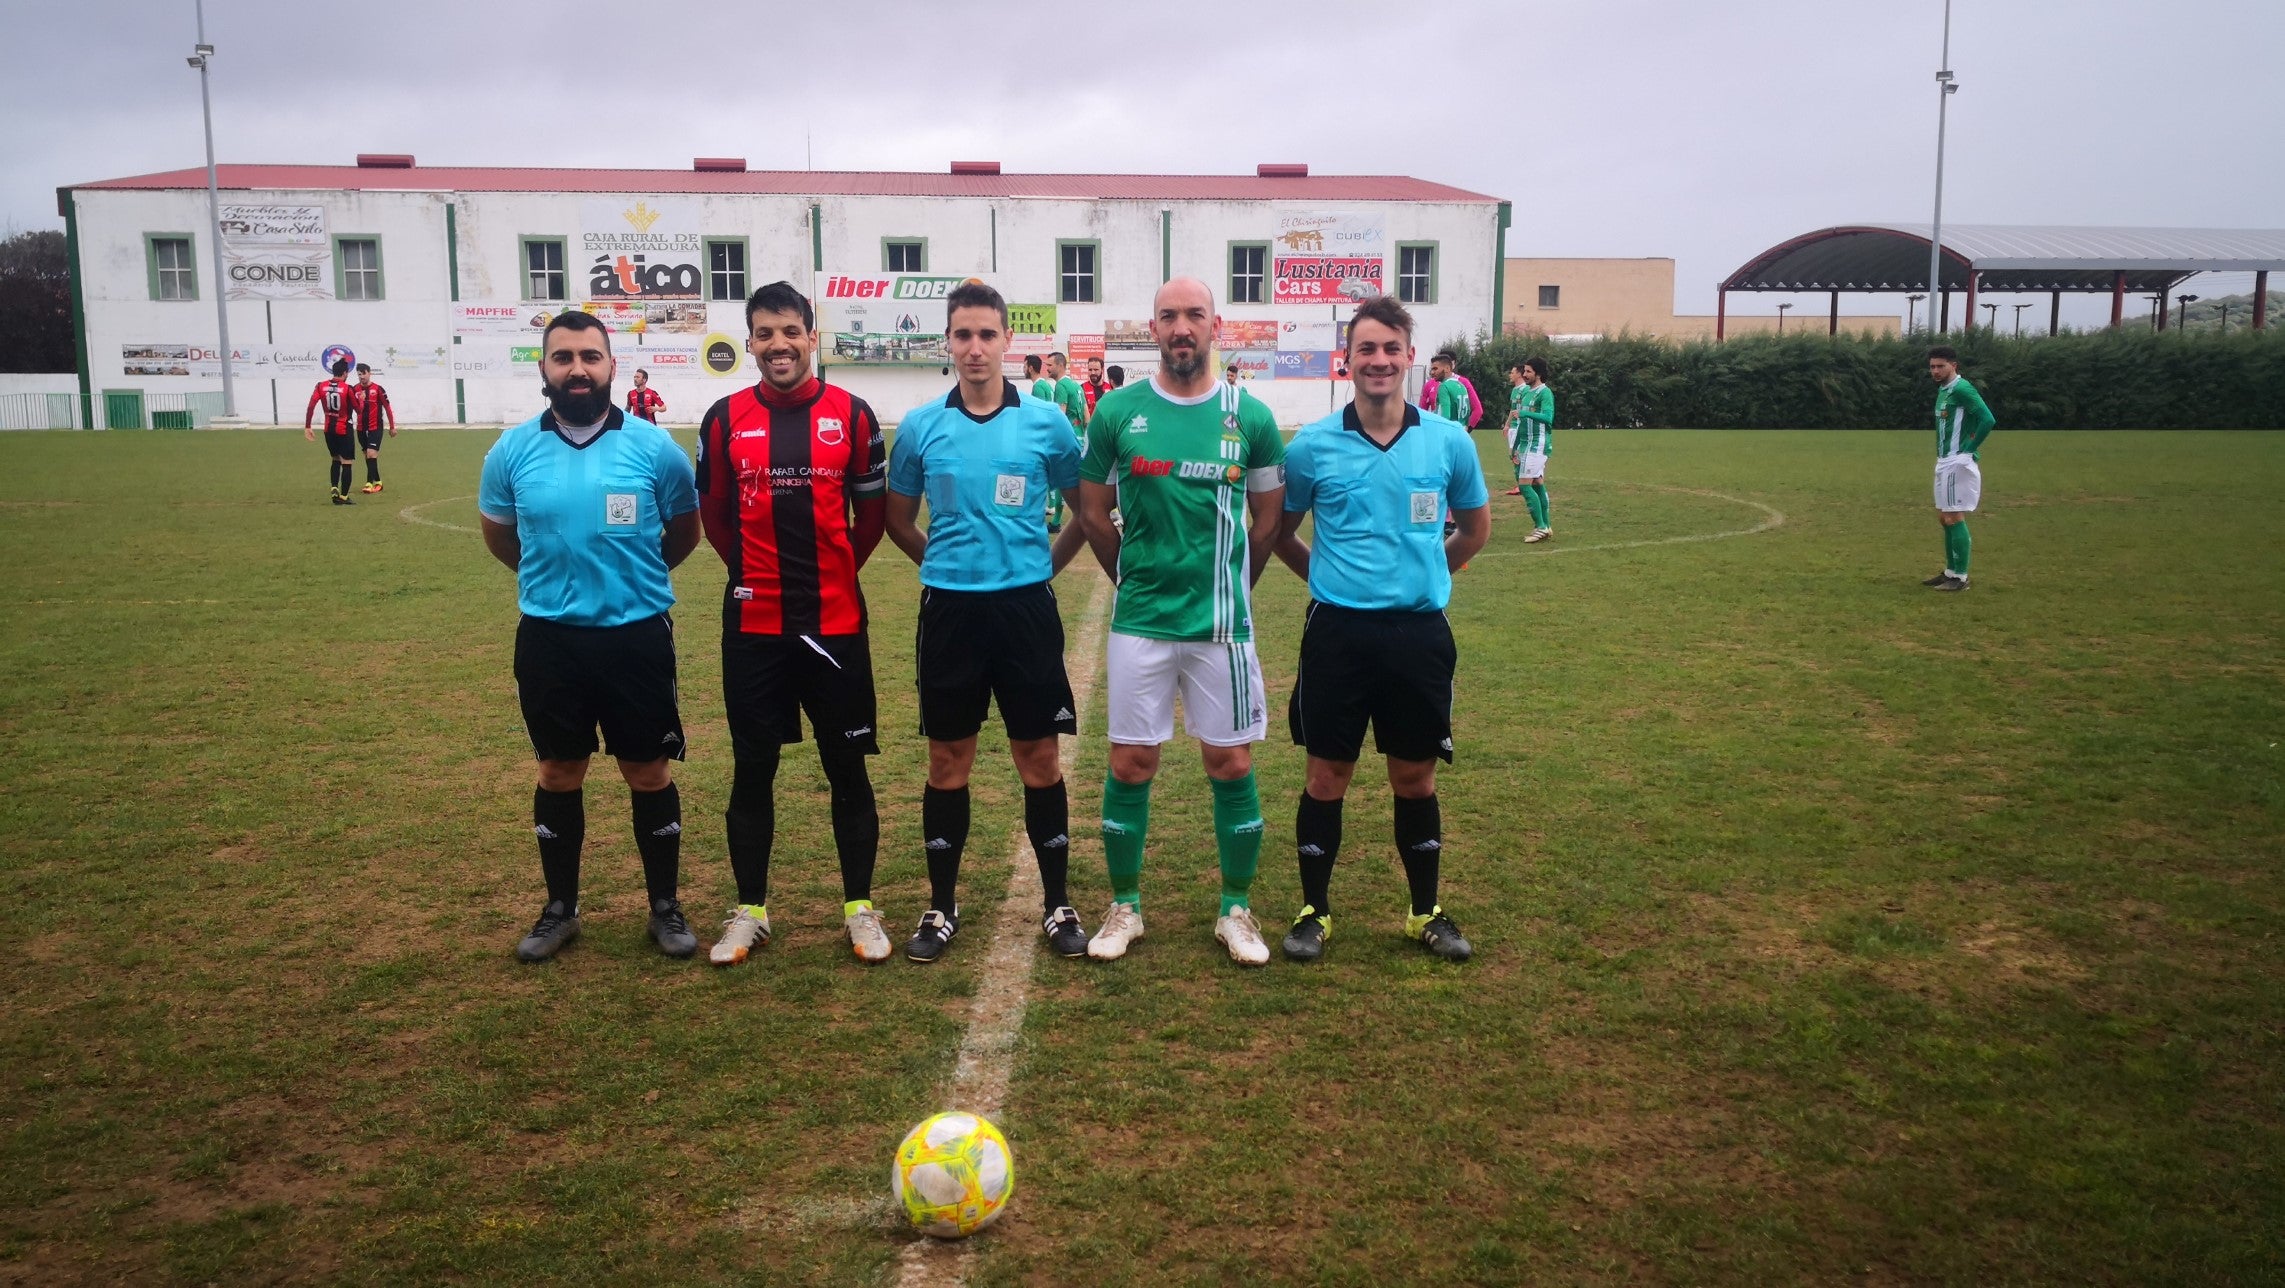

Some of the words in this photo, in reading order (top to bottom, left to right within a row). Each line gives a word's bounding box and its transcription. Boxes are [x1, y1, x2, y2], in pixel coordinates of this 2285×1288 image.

[583, 233, 618, 243] CAJA
[621, 233, 669, 243] RURAL
[675, 233, 699, 243] DE
[585, 243, 701, 251] EXTREMADURA
[229, 265, 320, 282] CONDE
[1276, 259, 1382, 279] Lusitania
[590, 254, 702, 298] ático
[826, 277, 890, 298] iber
[1275, 279, 1321, 295] Cars
[466, 307, 517, 316] MAPFRE
[1070, 335, 1104, 344] SERVITRUCK
[190, 348, 250, 361] DELA2
[655, 355, 687, 364] SPAR
[1275, 355, 1301, 365] MGS
[325, 393, 341, 411] 10
[764, 467, 797, 476] RAFAEL
[1131, 456, 1175, 476] iber
[1179, 461, 1227, 480] DOEX
